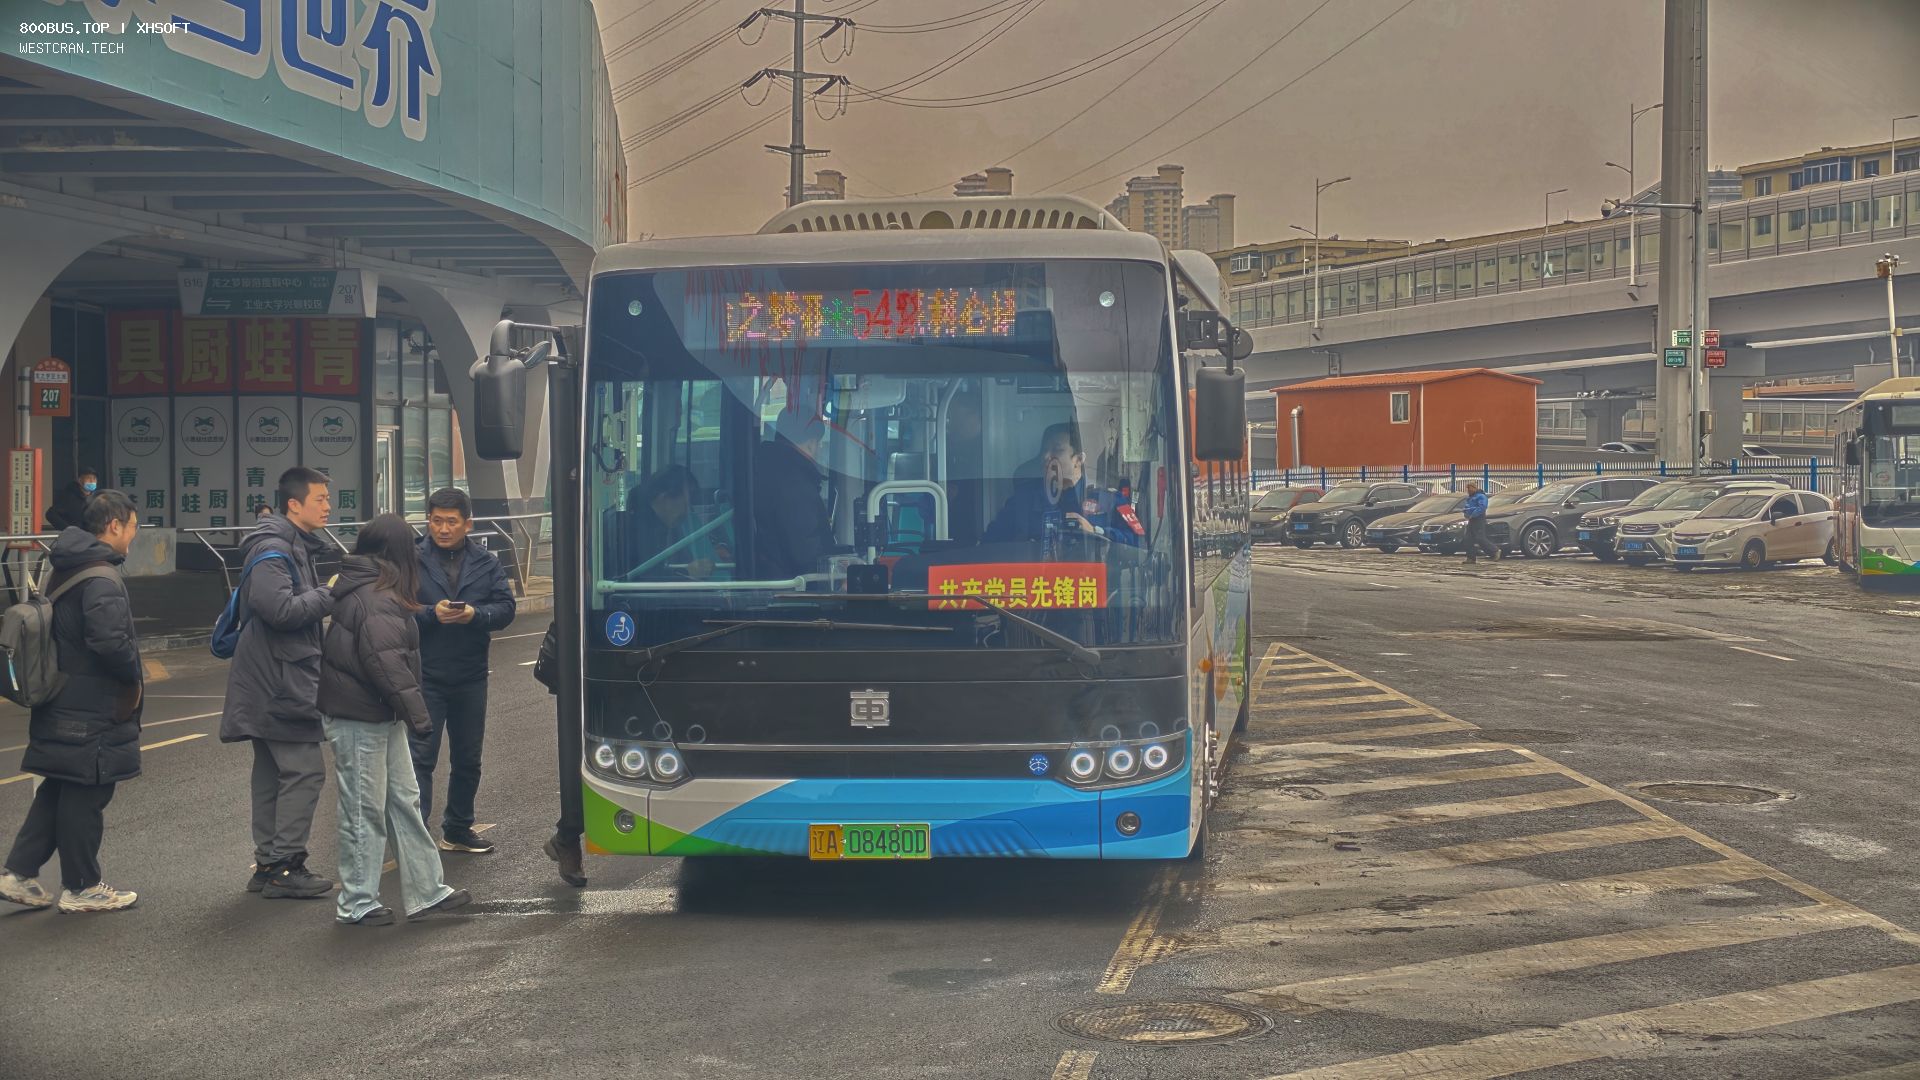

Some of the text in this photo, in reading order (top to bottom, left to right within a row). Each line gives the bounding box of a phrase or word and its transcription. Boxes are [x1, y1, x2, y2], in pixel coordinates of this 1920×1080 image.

[337, 284, 358, 295] 207
[42, 389, 59, 402] 207
[938, 576, 1098, 609] 共产党员先锋岗
